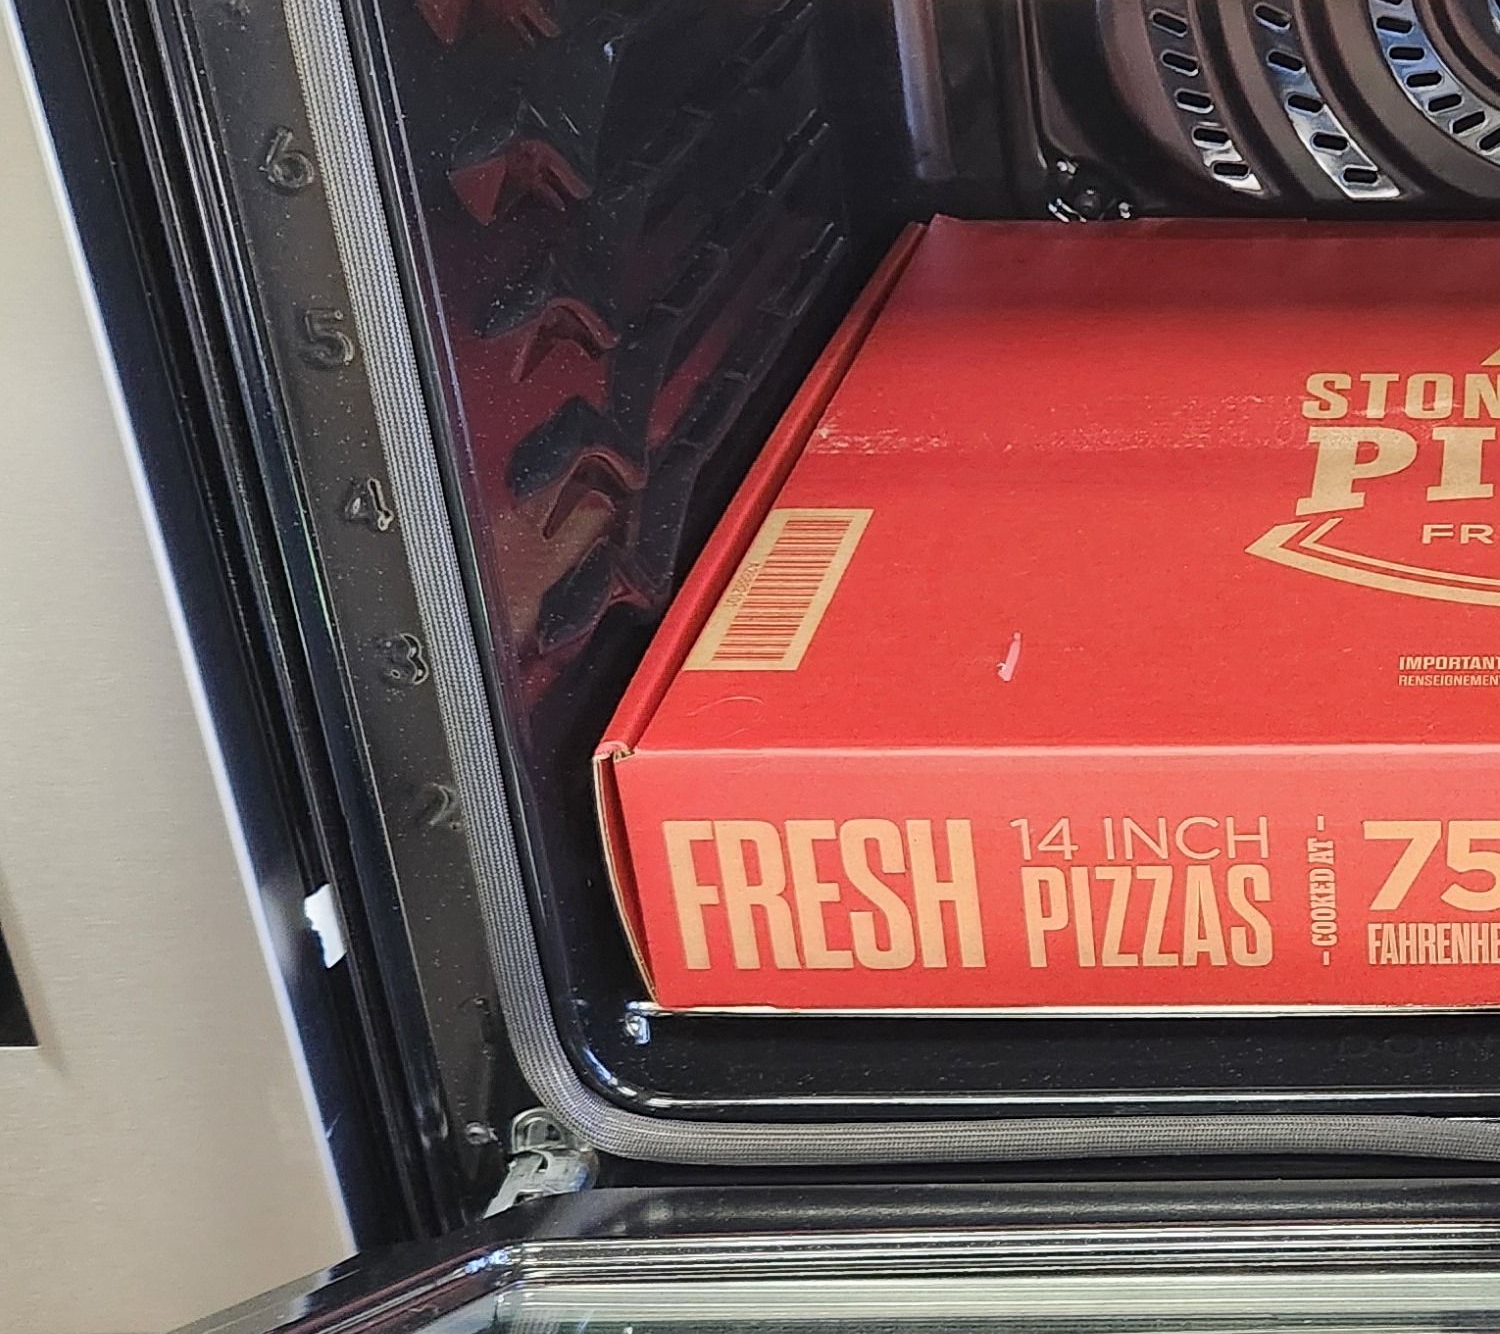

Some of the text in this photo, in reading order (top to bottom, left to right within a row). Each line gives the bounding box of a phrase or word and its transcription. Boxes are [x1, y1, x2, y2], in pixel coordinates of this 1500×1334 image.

[264, 127, 314, 189] 6
[303, 308, 354, 366] 5
[343, 477, 394, 532] 4
[1010, 816, 1269, 861] 14 INCH
[661, 818, 986, 970] FRESH
[1020, 864, 1273, 968] PIZZAS
[1308, 838, 1338, 947] COOKED AT
